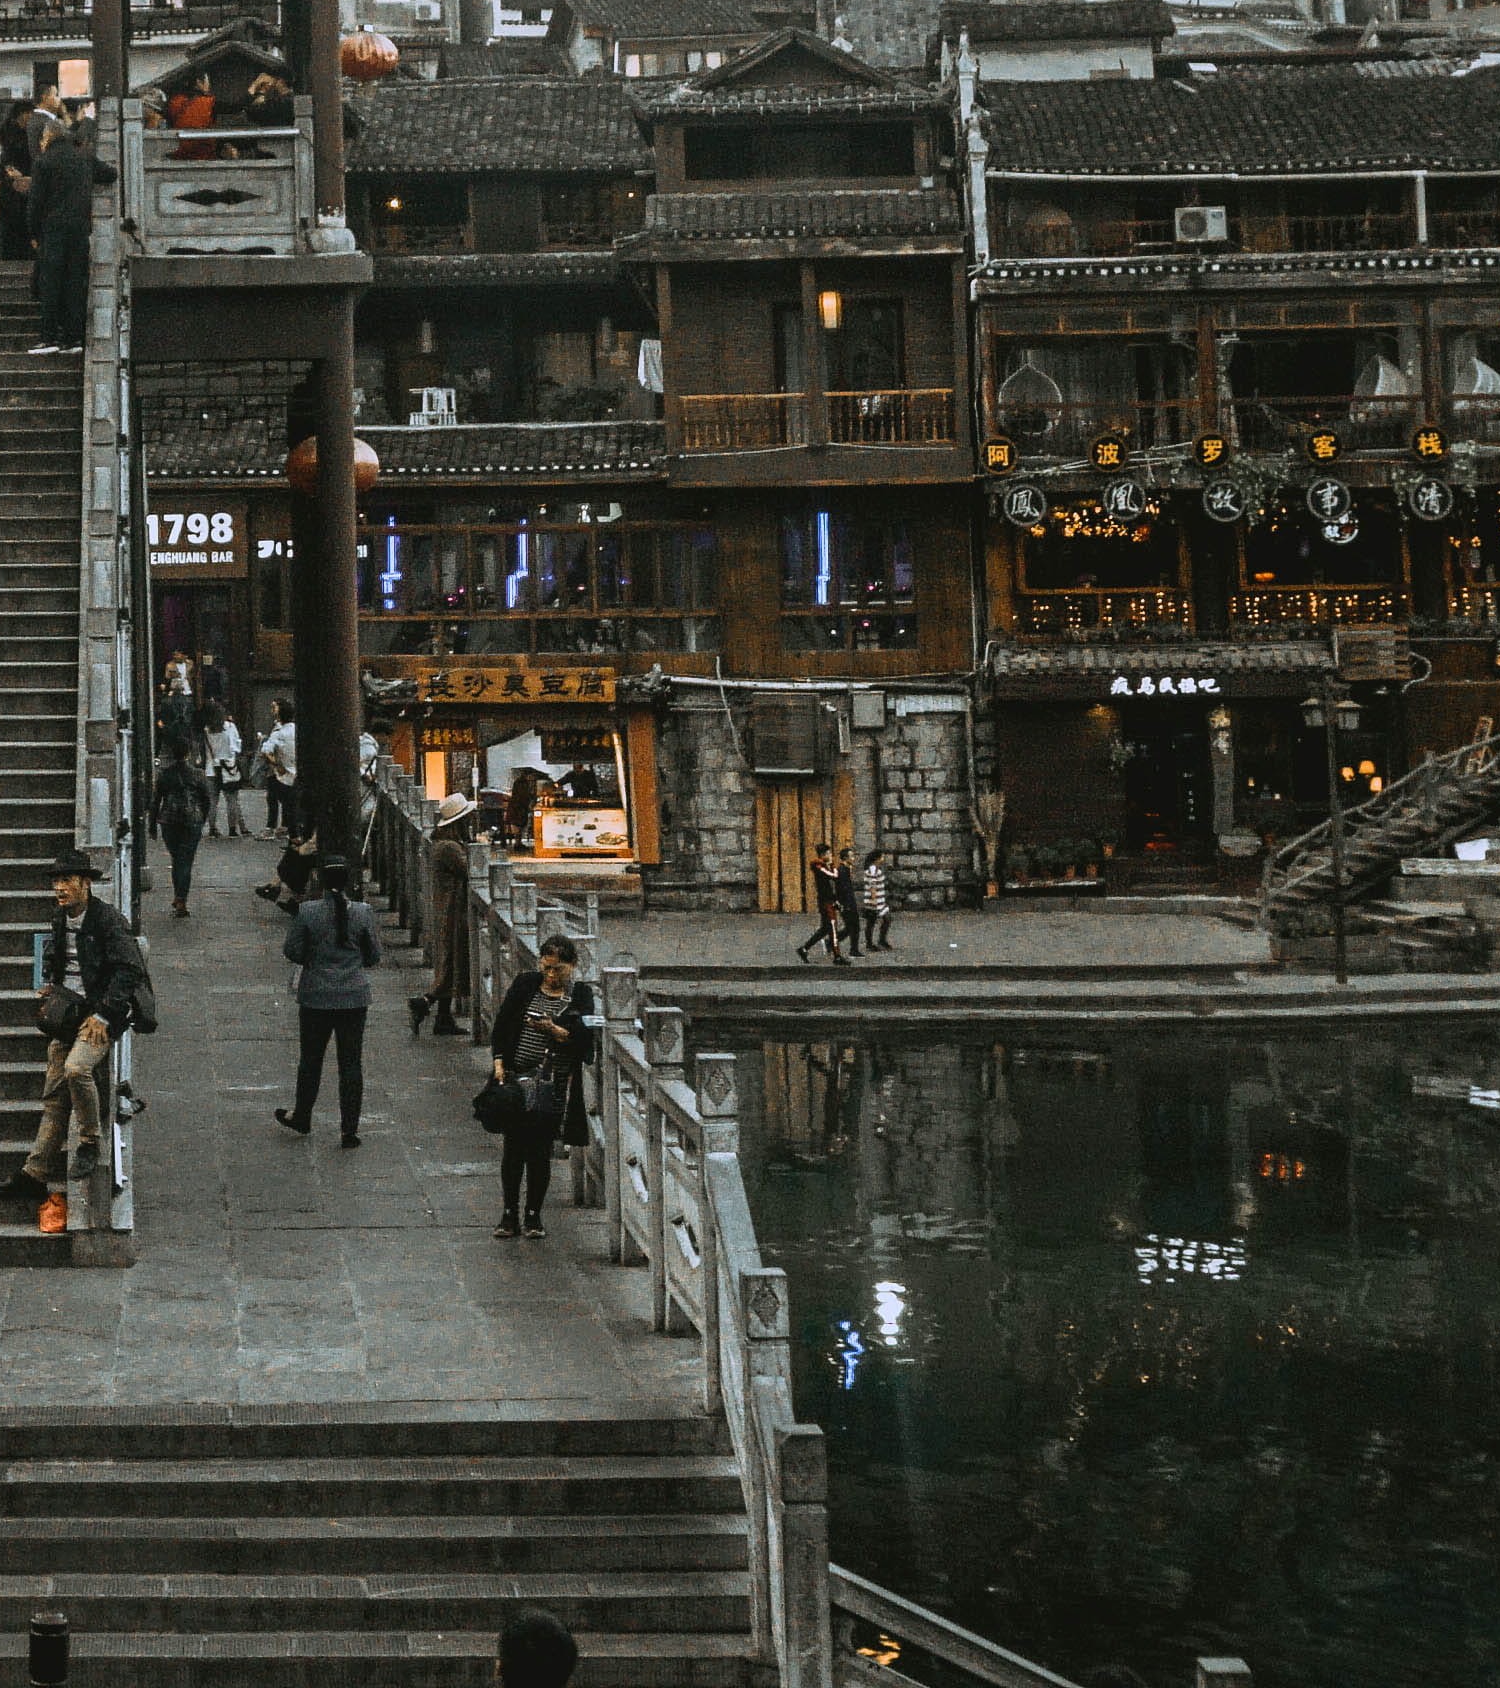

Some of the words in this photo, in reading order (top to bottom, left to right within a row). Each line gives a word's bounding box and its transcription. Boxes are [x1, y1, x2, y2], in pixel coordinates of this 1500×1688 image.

[987, 432, 1443, 467] 阿波罗客栈
[146, 513, 233, 545] 1798
[149, 551, 207, 564] ENGHUANG
[211, 551, 233, 562] BAR
